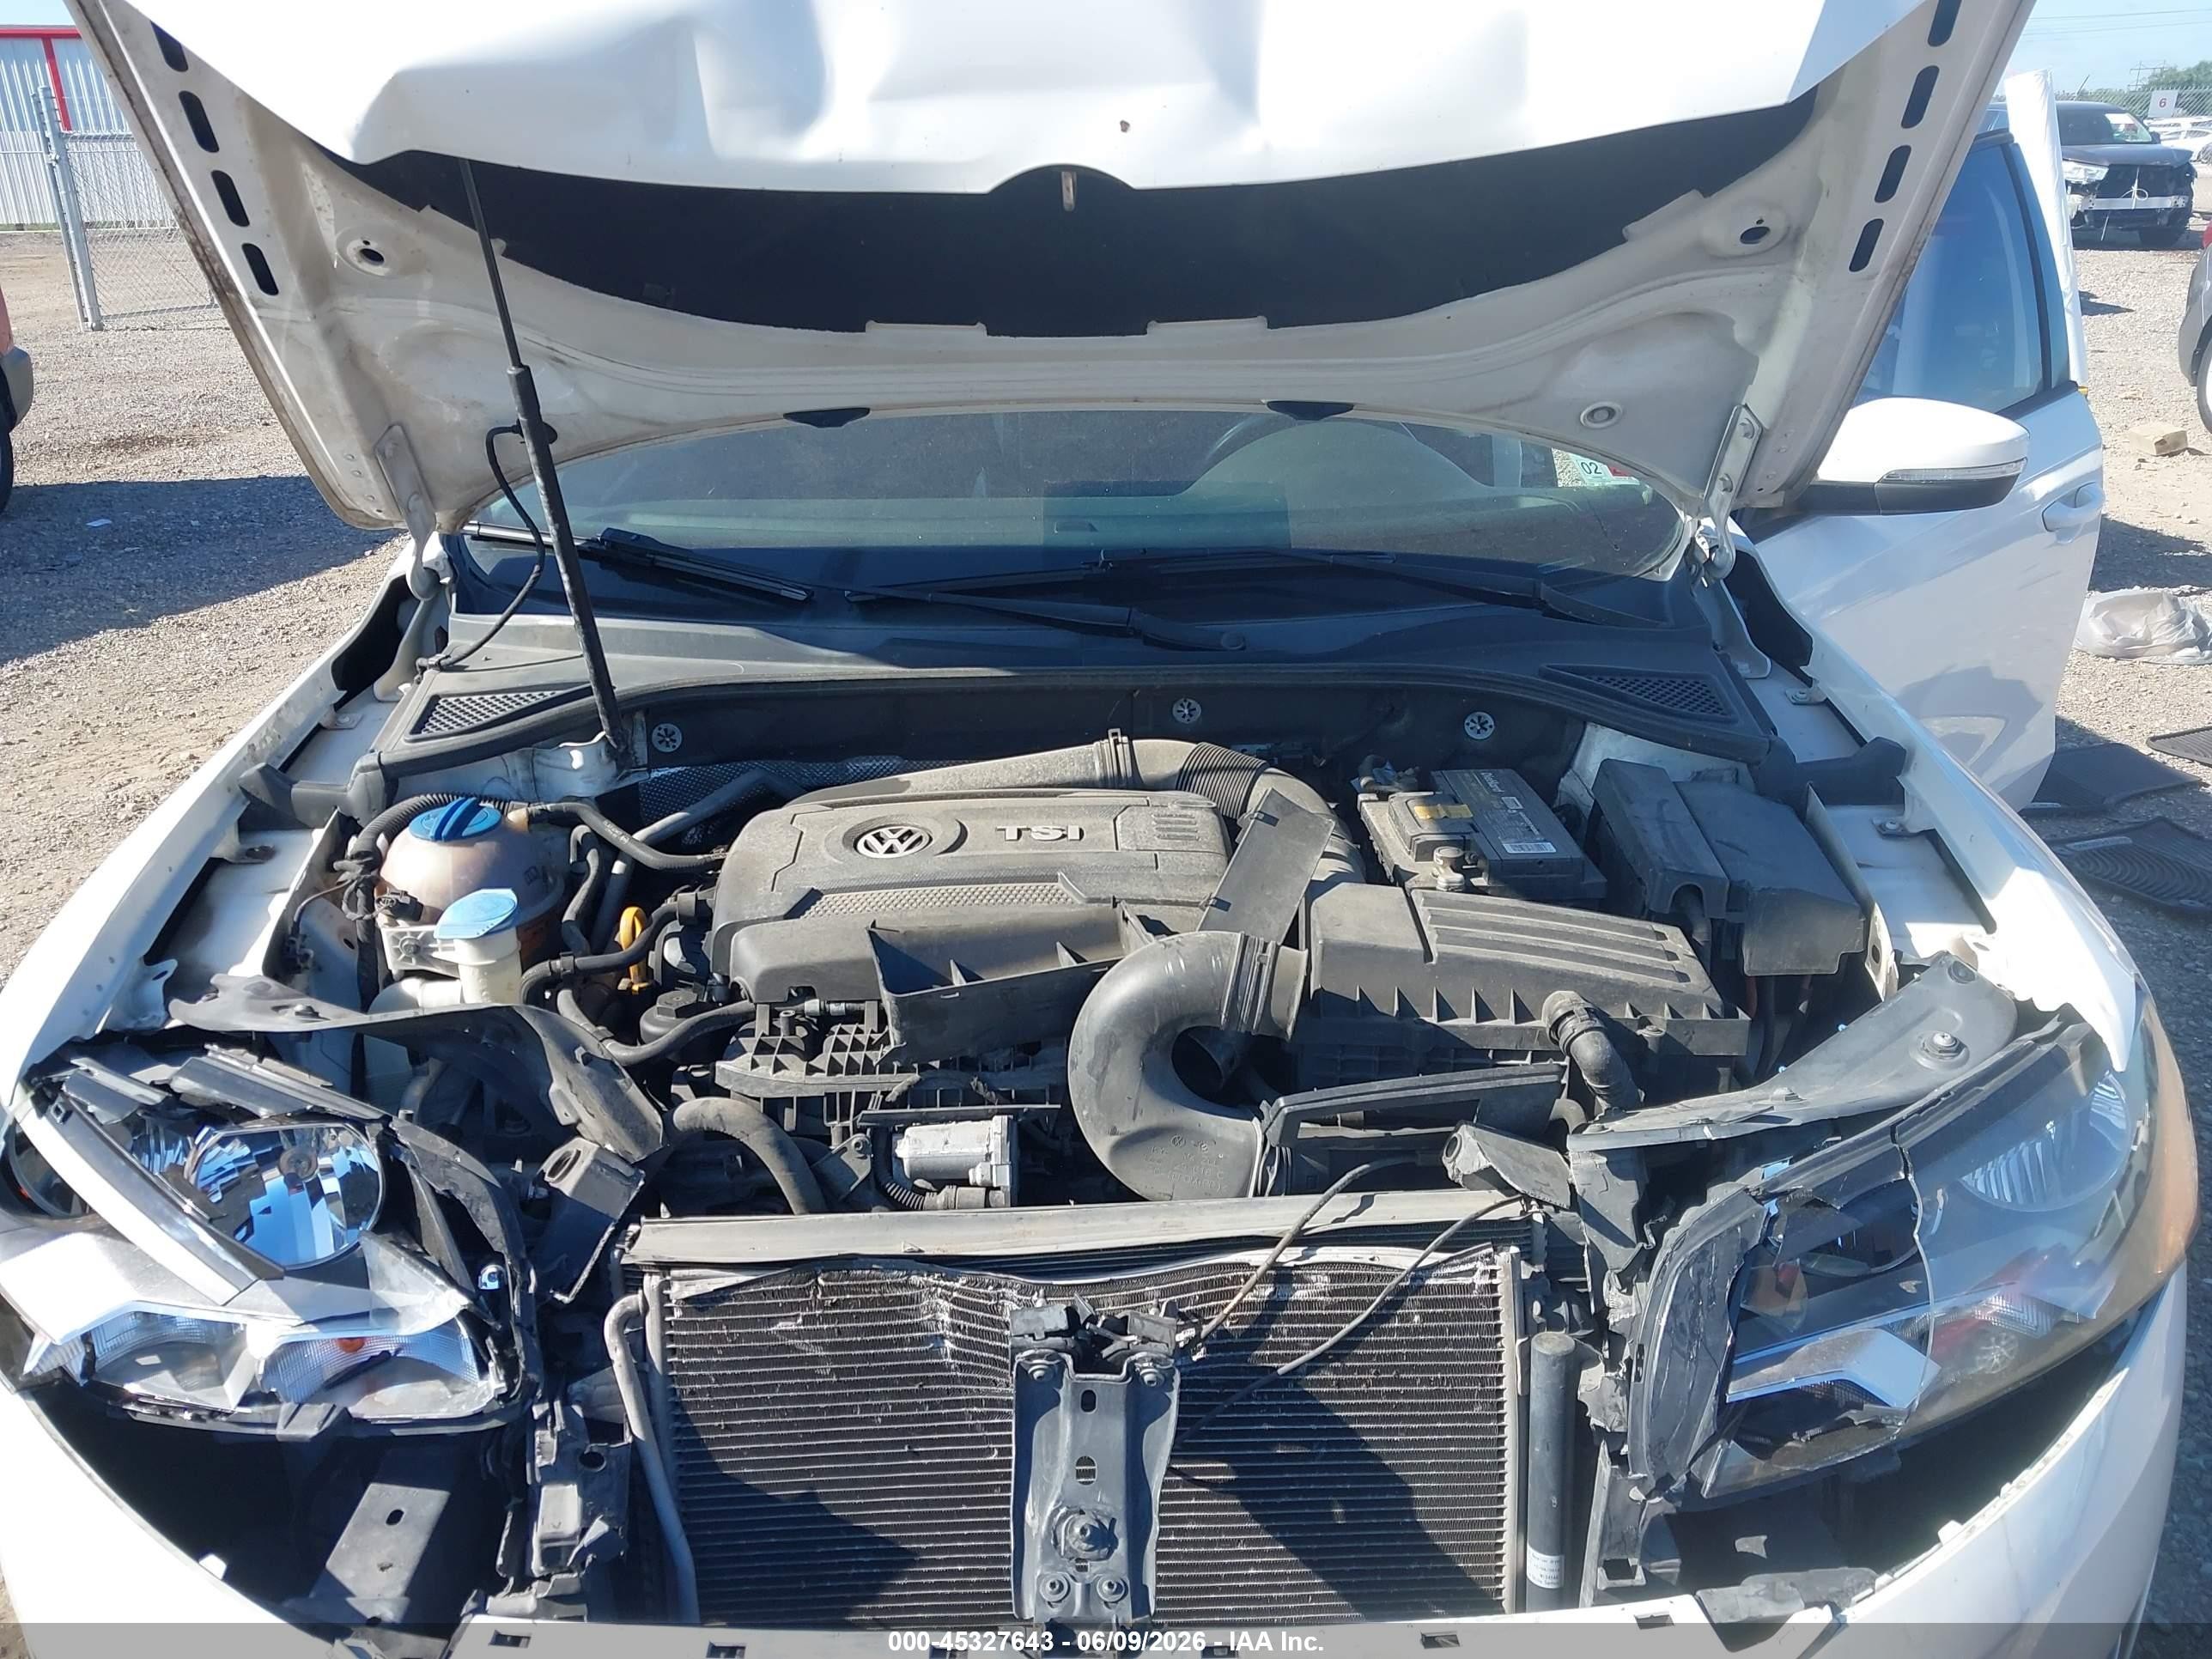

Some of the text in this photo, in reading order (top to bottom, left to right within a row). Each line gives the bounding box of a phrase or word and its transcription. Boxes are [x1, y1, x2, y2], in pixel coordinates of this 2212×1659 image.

[2159, 98, 2167, 108] 6
[1581, 462, 1602, 475] 02
[995, 824, 1085, 842] TSI
